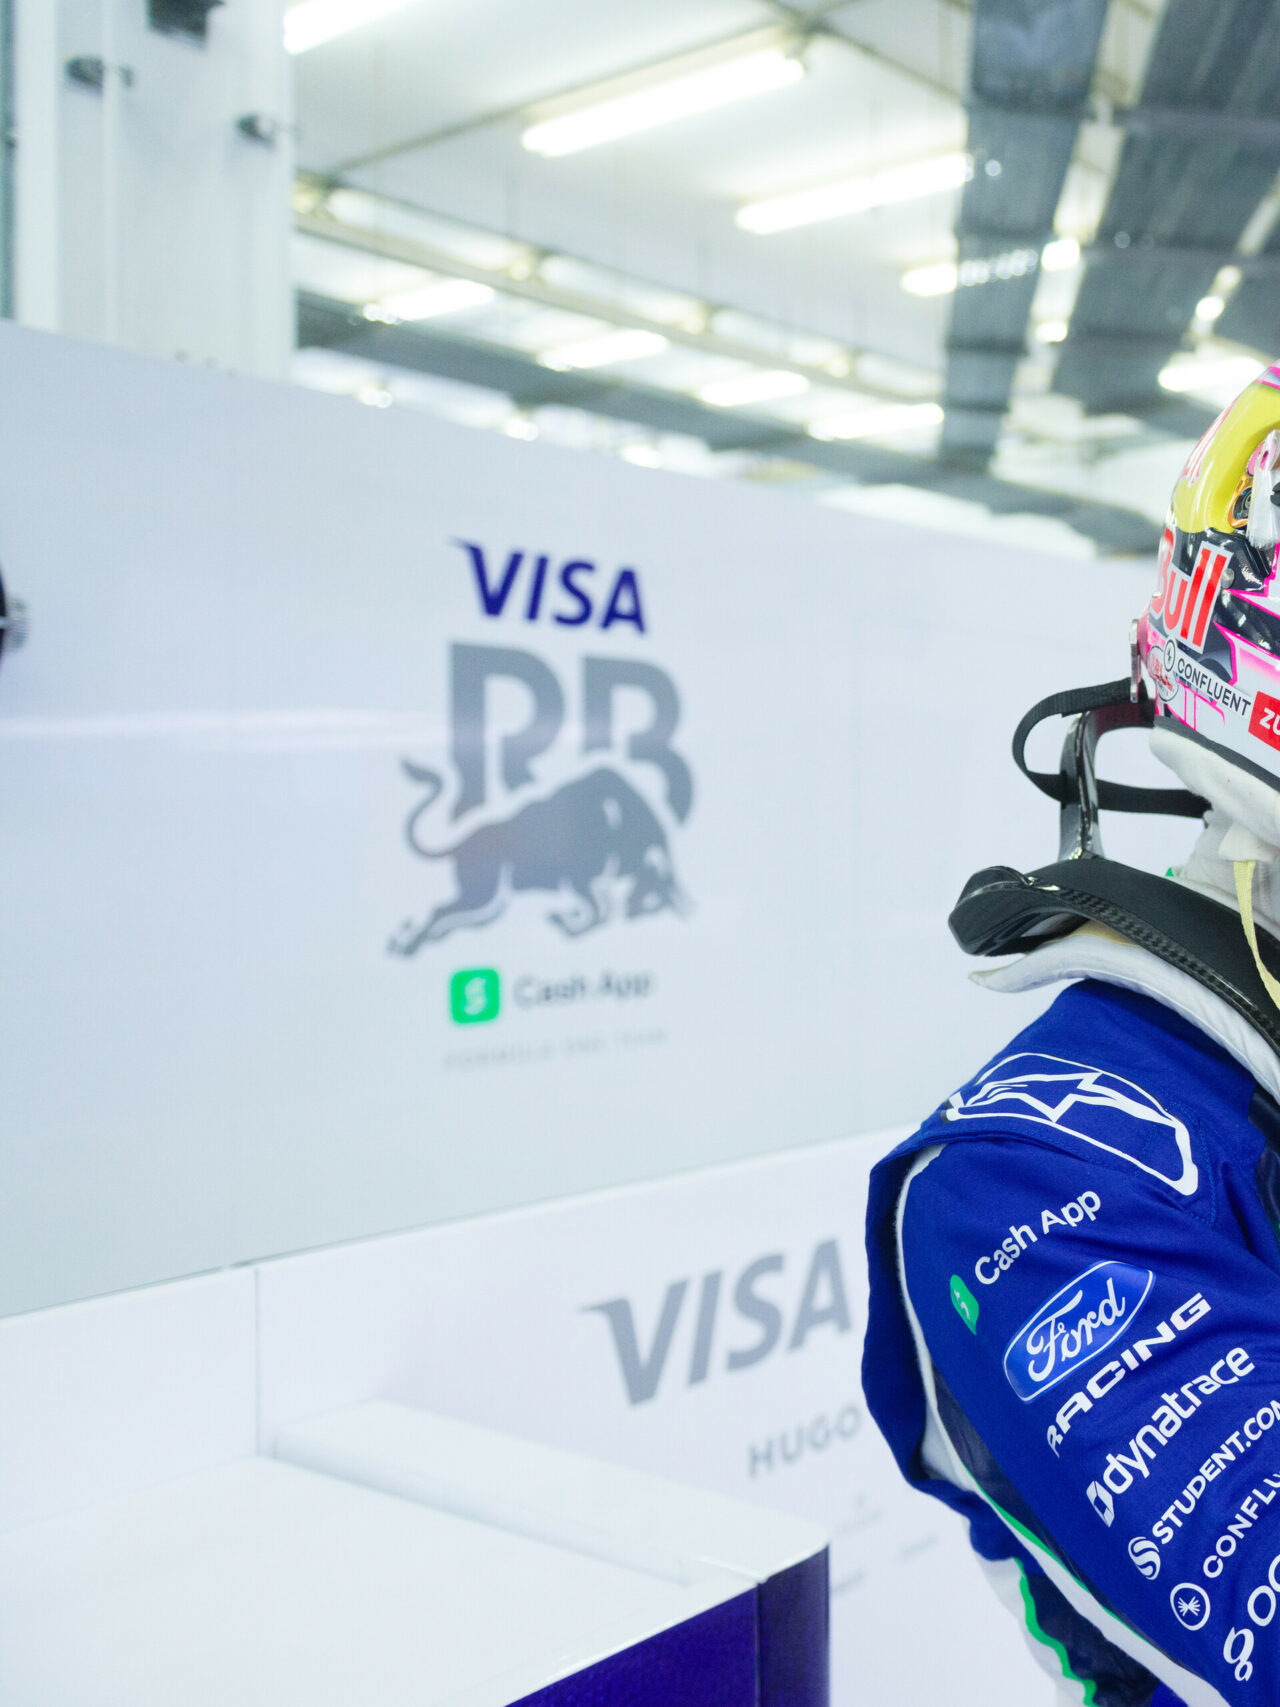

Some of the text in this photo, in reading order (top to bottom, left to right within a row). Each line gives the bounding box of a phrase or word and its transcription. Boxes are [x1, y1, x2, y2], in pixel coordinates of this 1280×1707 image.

[449, 538, 648, 635] VISA
[1177, 657, 1252, 717] CONFLUENT
[974, 1190, 1102, 1285] Cash App
[578, 1237, 853, 1408] VISA
[1026, 1277, 1126, 1382] Ford
[1046, 1292, 1212, 1459] RACING
[1102, 1347, 1256, 1495] dynatrace
[747, 1405, 864, 1479] HUGO
